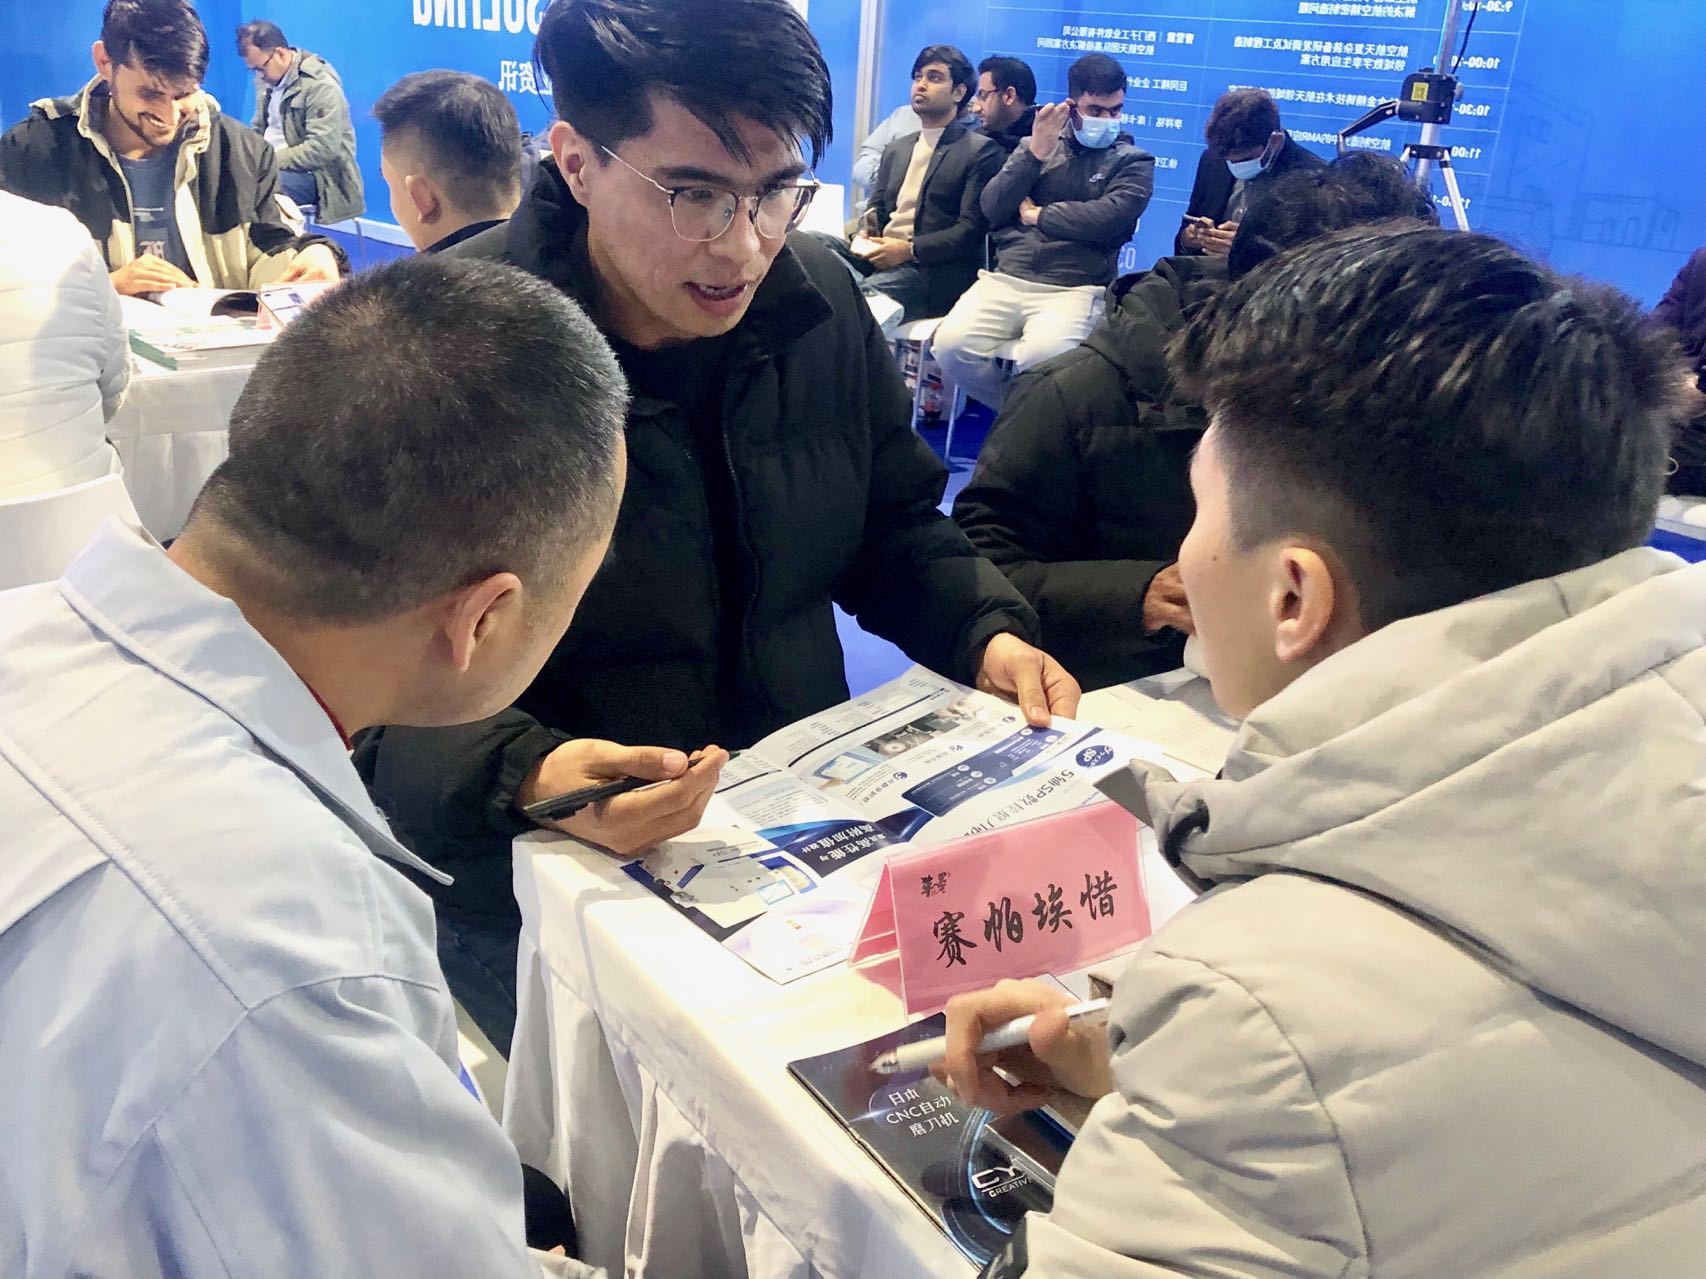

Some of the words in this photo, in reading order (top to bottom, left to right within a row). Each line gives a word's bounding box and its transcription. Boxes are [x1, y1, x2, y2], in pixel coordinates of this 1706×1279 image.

[886, 1095, 951, 1124] CNC自动
[888, 1088, 920, 1106] 日本
[908, 1112, 960, 1138] 磨刀机
